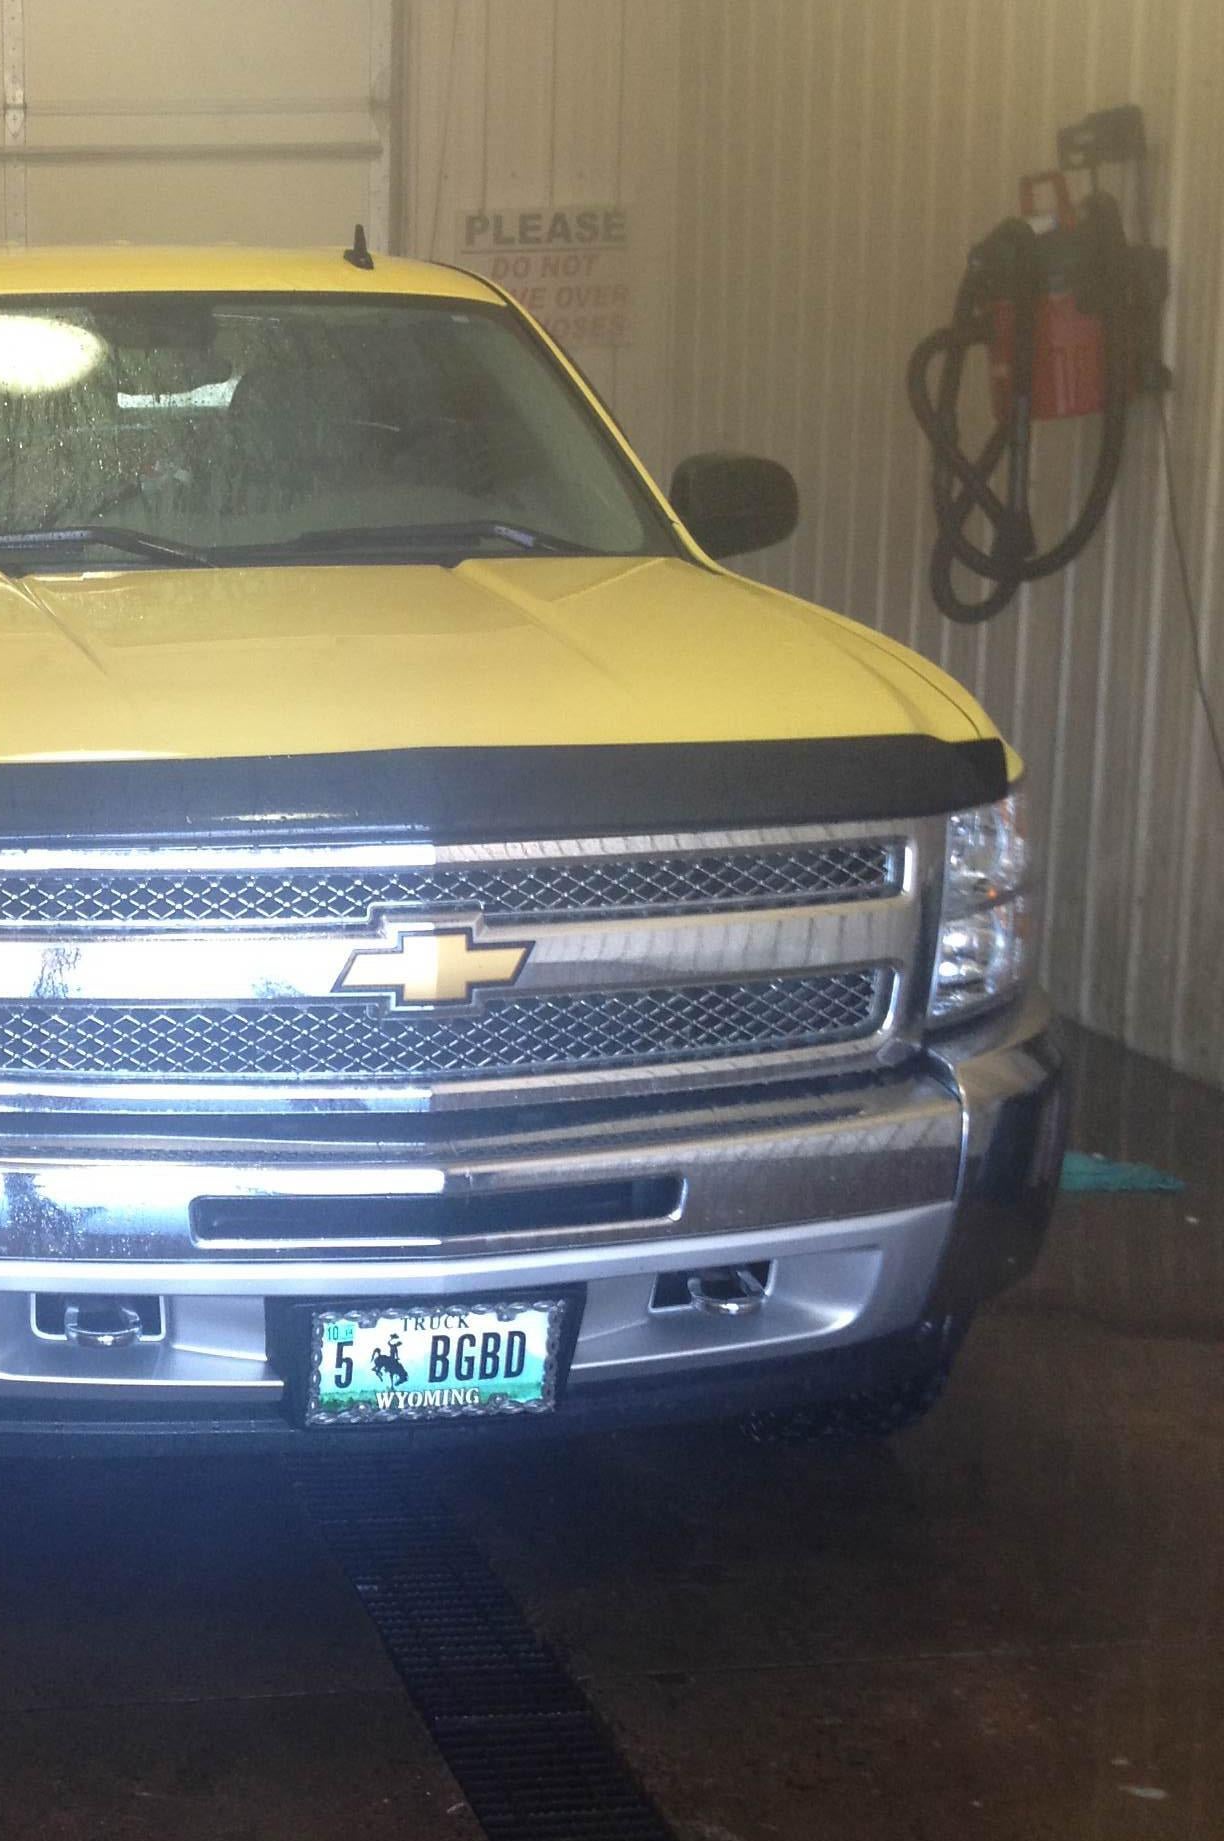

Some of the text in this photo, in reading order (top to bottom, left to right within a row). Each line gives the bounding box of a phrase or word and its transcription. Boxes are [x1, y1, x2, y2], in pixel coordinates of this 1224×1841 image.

[464, 211, 627, 246] PLEASE
[491, 254, 600, 279] DO NOT
[555, 284, 629, 309] OVER
[546, 312, 626, 339] OSES
[327, 1325, 339, 1341] 10
[400, 1314, 470, 1331] TRUCK
[334, 1330, 527, 1388] 5 BGBD
[375, 1387, 480, 1410] WYOMING
